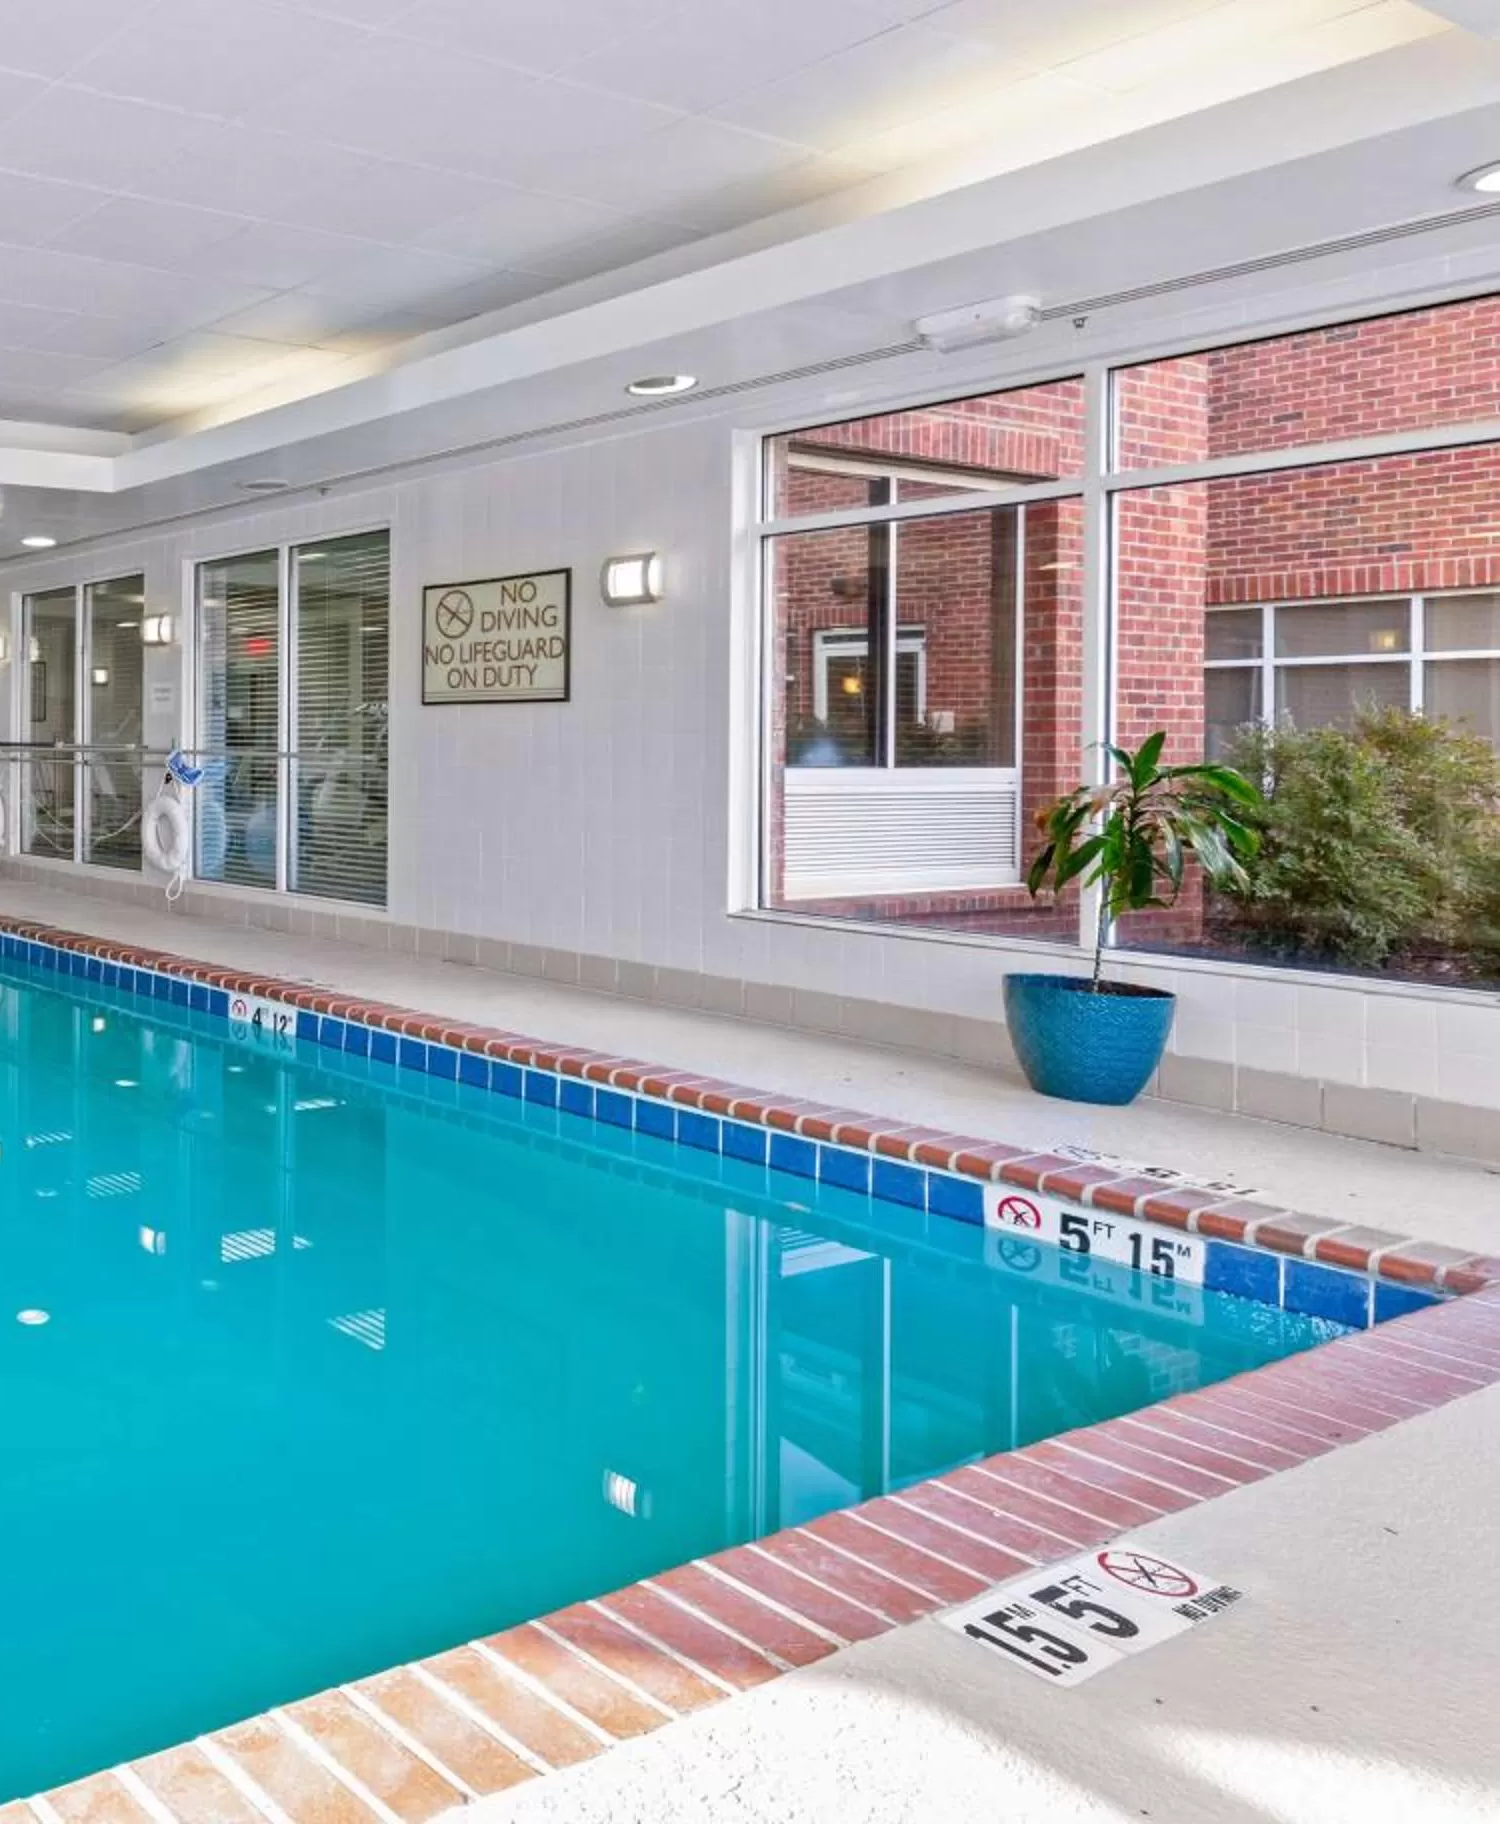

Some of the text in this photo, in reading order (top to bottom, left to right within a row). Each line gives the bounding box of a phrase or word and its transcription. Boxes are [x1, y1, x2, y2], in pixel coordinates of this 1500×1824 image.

[501, 581, 536, 605] NO
[481, 605, 557, 632] DIVING
[425, 636, 565, 665] NO LIFEGUARD
[447, 664, 538, 688] ON DUTY
[1059, 1212, 1091, 1253] 5
[1093, 1221, 1116, 1239] FT
[1030, 1585, 1140, 1638] 5
